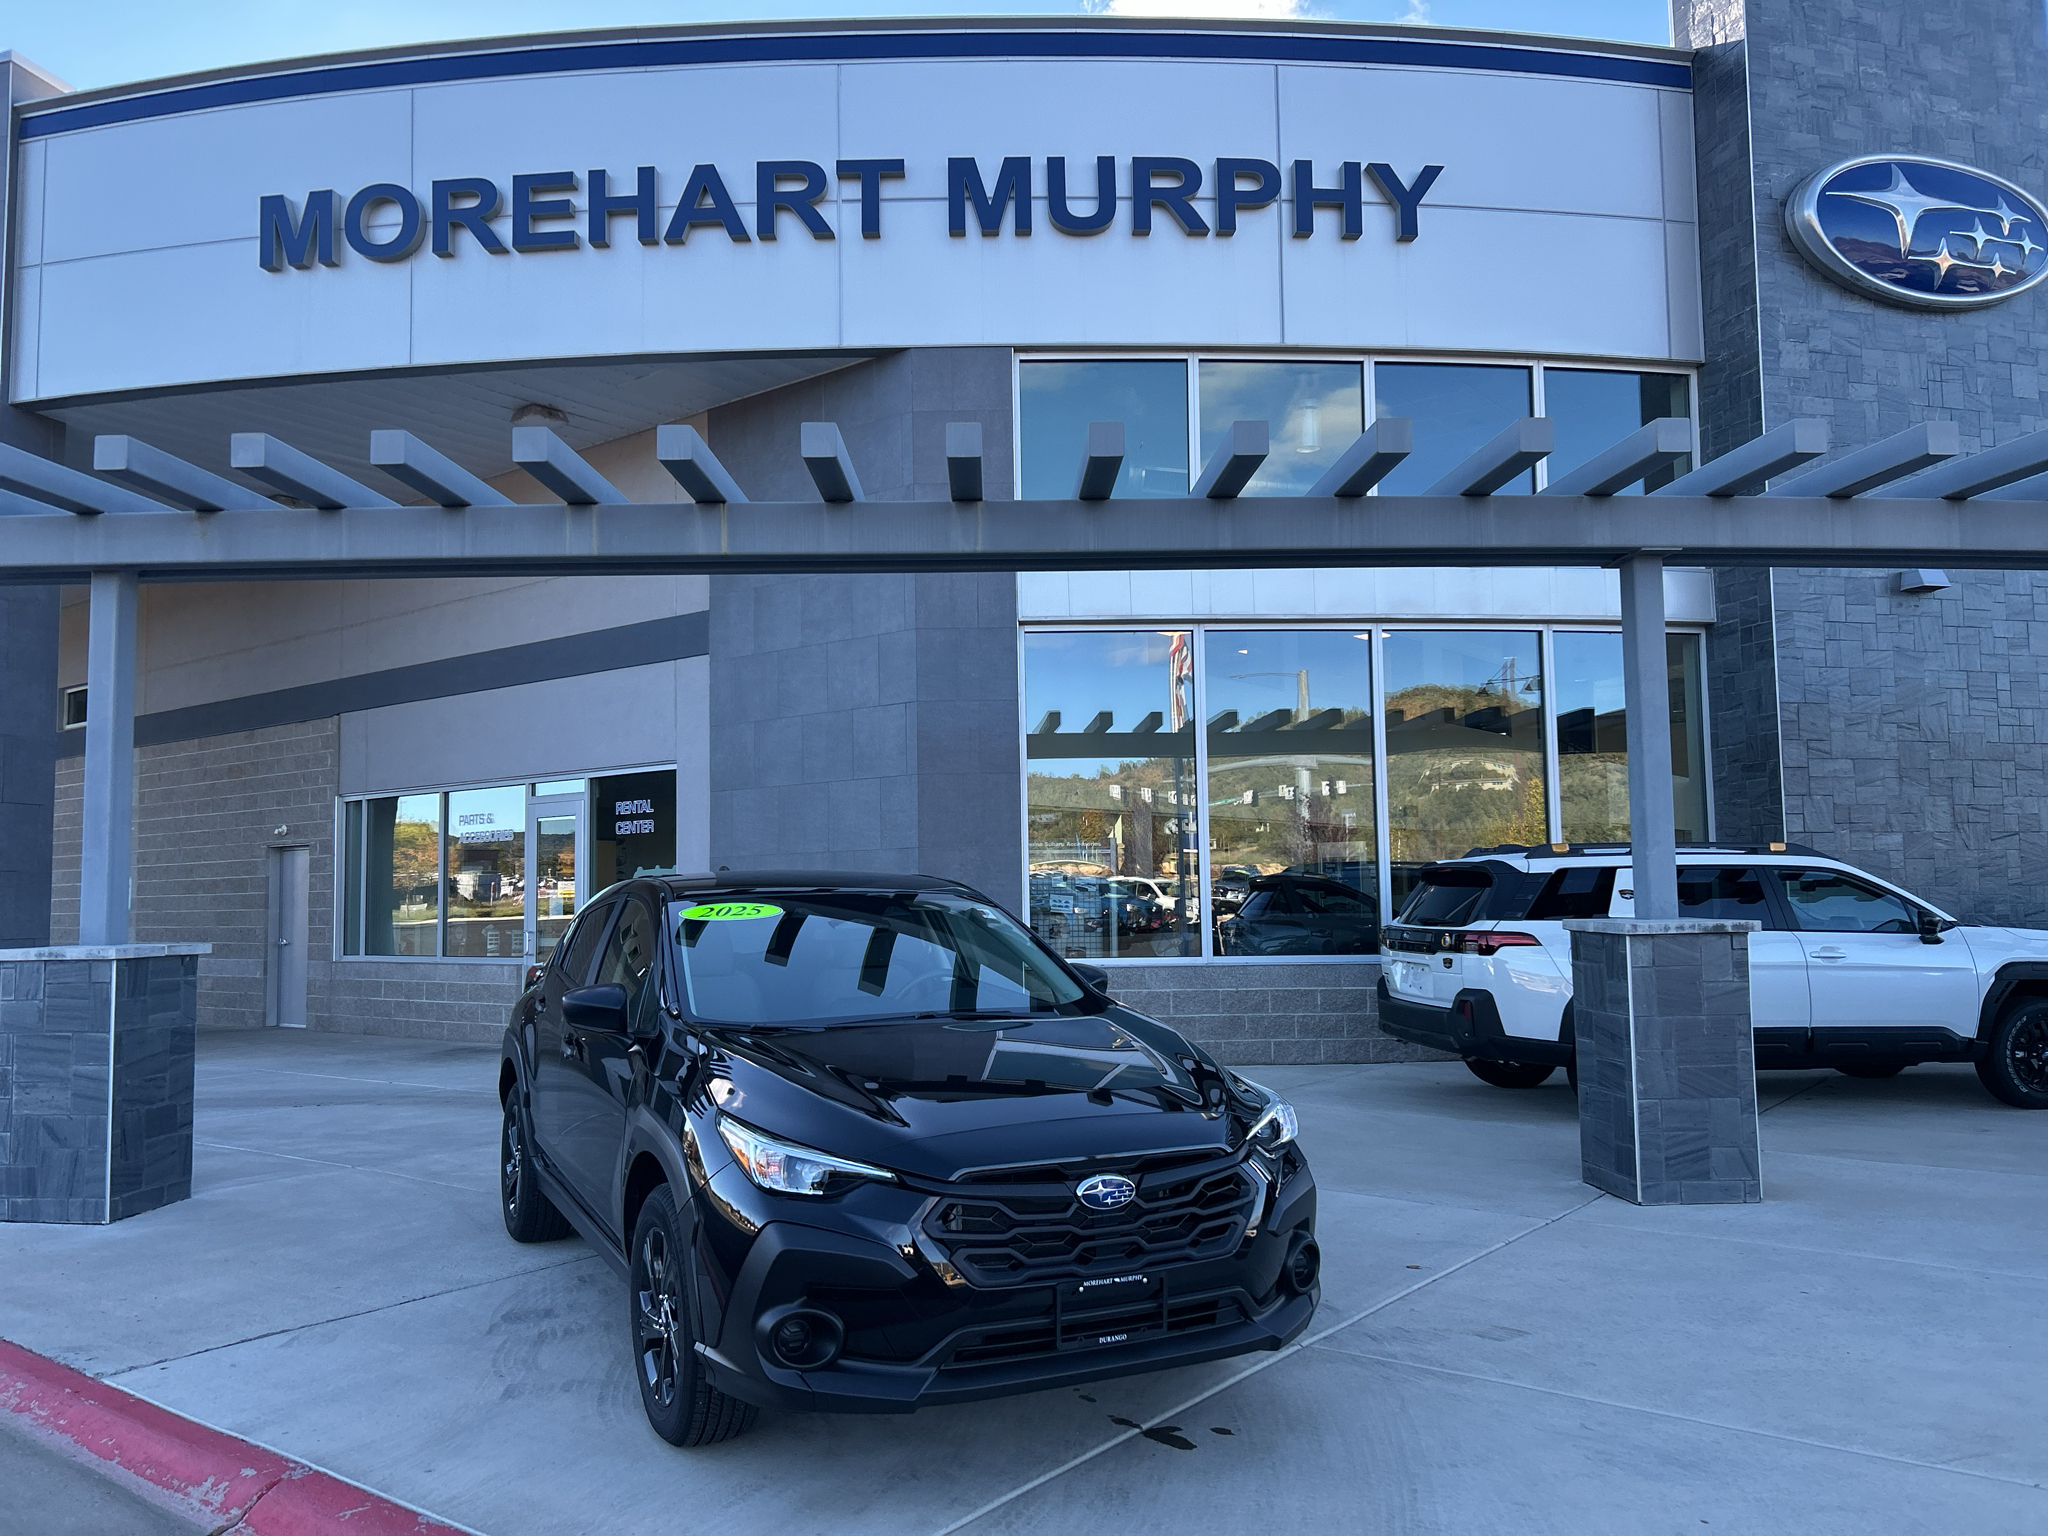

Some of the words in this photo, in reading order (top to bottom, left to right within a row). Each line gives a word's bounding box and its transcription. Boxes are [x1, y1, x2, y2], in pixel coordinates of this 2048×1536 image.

[259, 158, 906, 272] MOREHART
[947, 155, 1445, 242] MURPHY
[615, 799, 654, 815] RENTAL
[459, 813, 486, 826] PARTS
[486, 812, 495, 824] &
[615, 819, 655, 835] CENTER
[458, 829, 514, 844] ACCESSORIES
[697, 905, 764, 918] 2025
[1083, 1278, 1113, 1286] MOREHART
[1120, 1274, 1143, 1282] MURPHY
[1099, 1334, 1127, 1343] DURANGO
